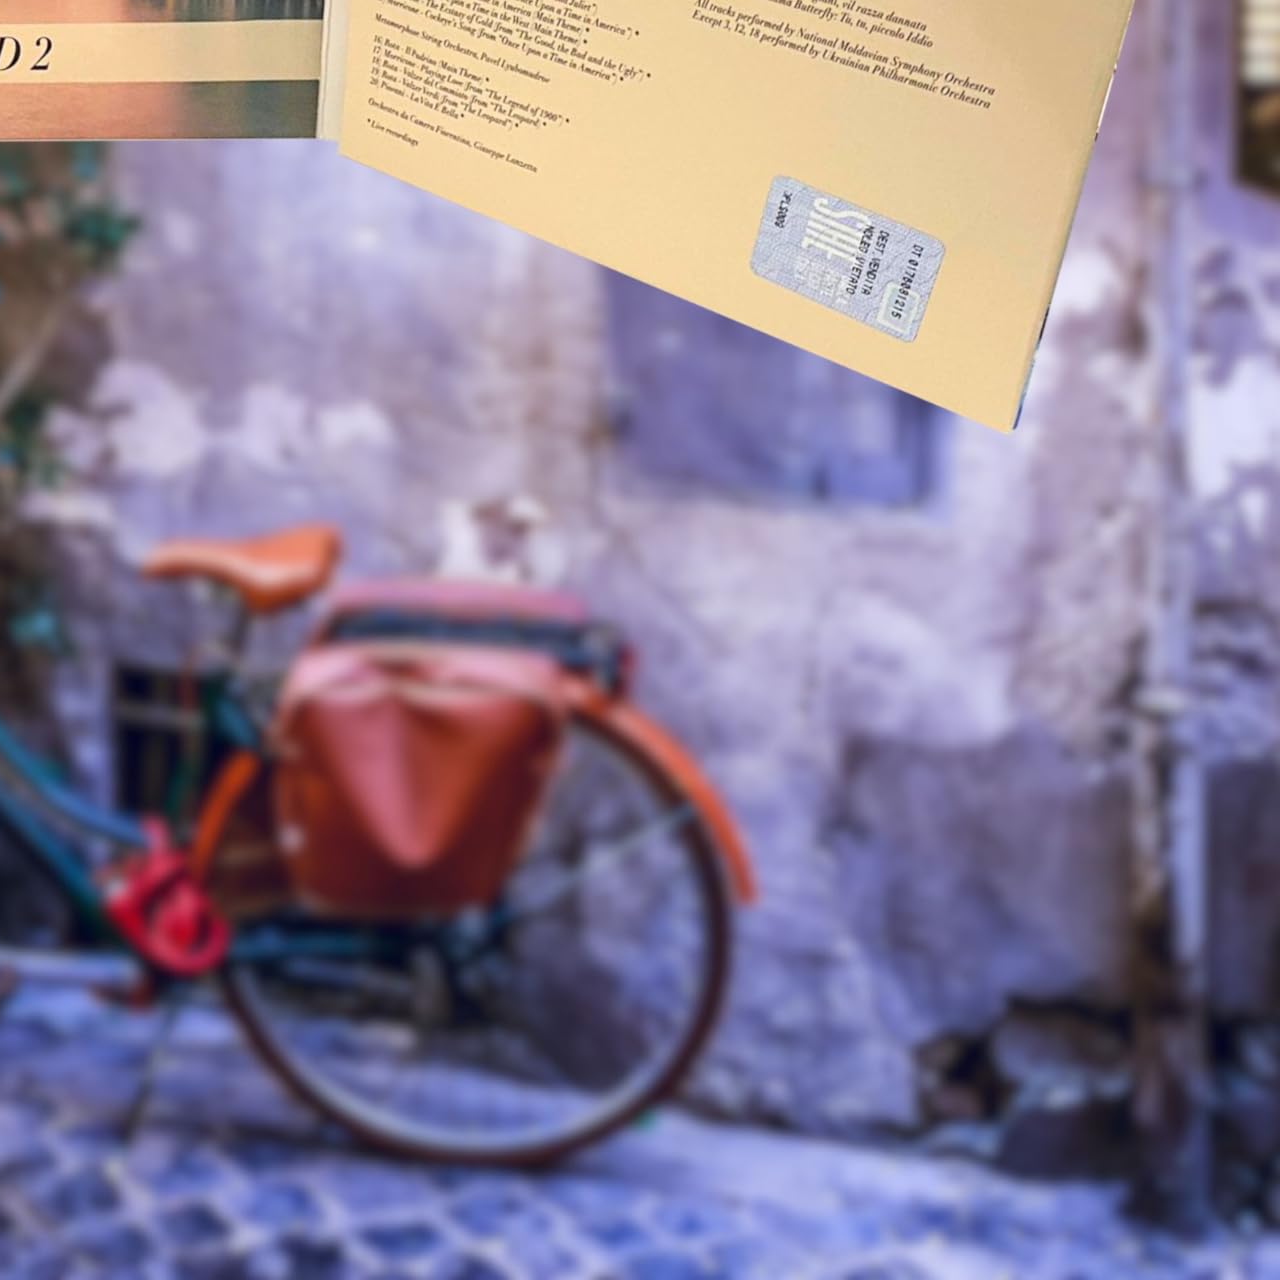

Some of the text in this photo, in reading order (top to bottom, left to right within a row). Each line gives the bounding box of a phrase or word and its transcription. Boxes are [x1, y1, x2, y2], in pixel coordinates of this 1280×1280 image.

[842, 0, 856, 10] vil
[855, 5, 883, 19] razza
[885, 11, 926, 30] dannata
[709, 3, 735, 17] tracks
[735, 12, 783, 31] performed
[781, 22, 795, 37] by
[796, 27, 838, 48] National
[838, 40, 888, 63] Moldavian
[890, 56, 942, 80] Symphony
[944, 72, 994, 95] Orchestra
[868, 22, 904, 38] piccolo
[905, 31, 932, 47] Iddio
[30, 36, 53, 71] 2
[692, 9, 722, 27] Except
[749, 27, 760, 38] 18
[759, 33, 808, 52] performed
[808, 44, 820, 58] by
[822, 49, 869, 71] Ukrainian
[872, 64, 938, 91] Philharmonic
[940, 85, 990, 108] Orchestra
